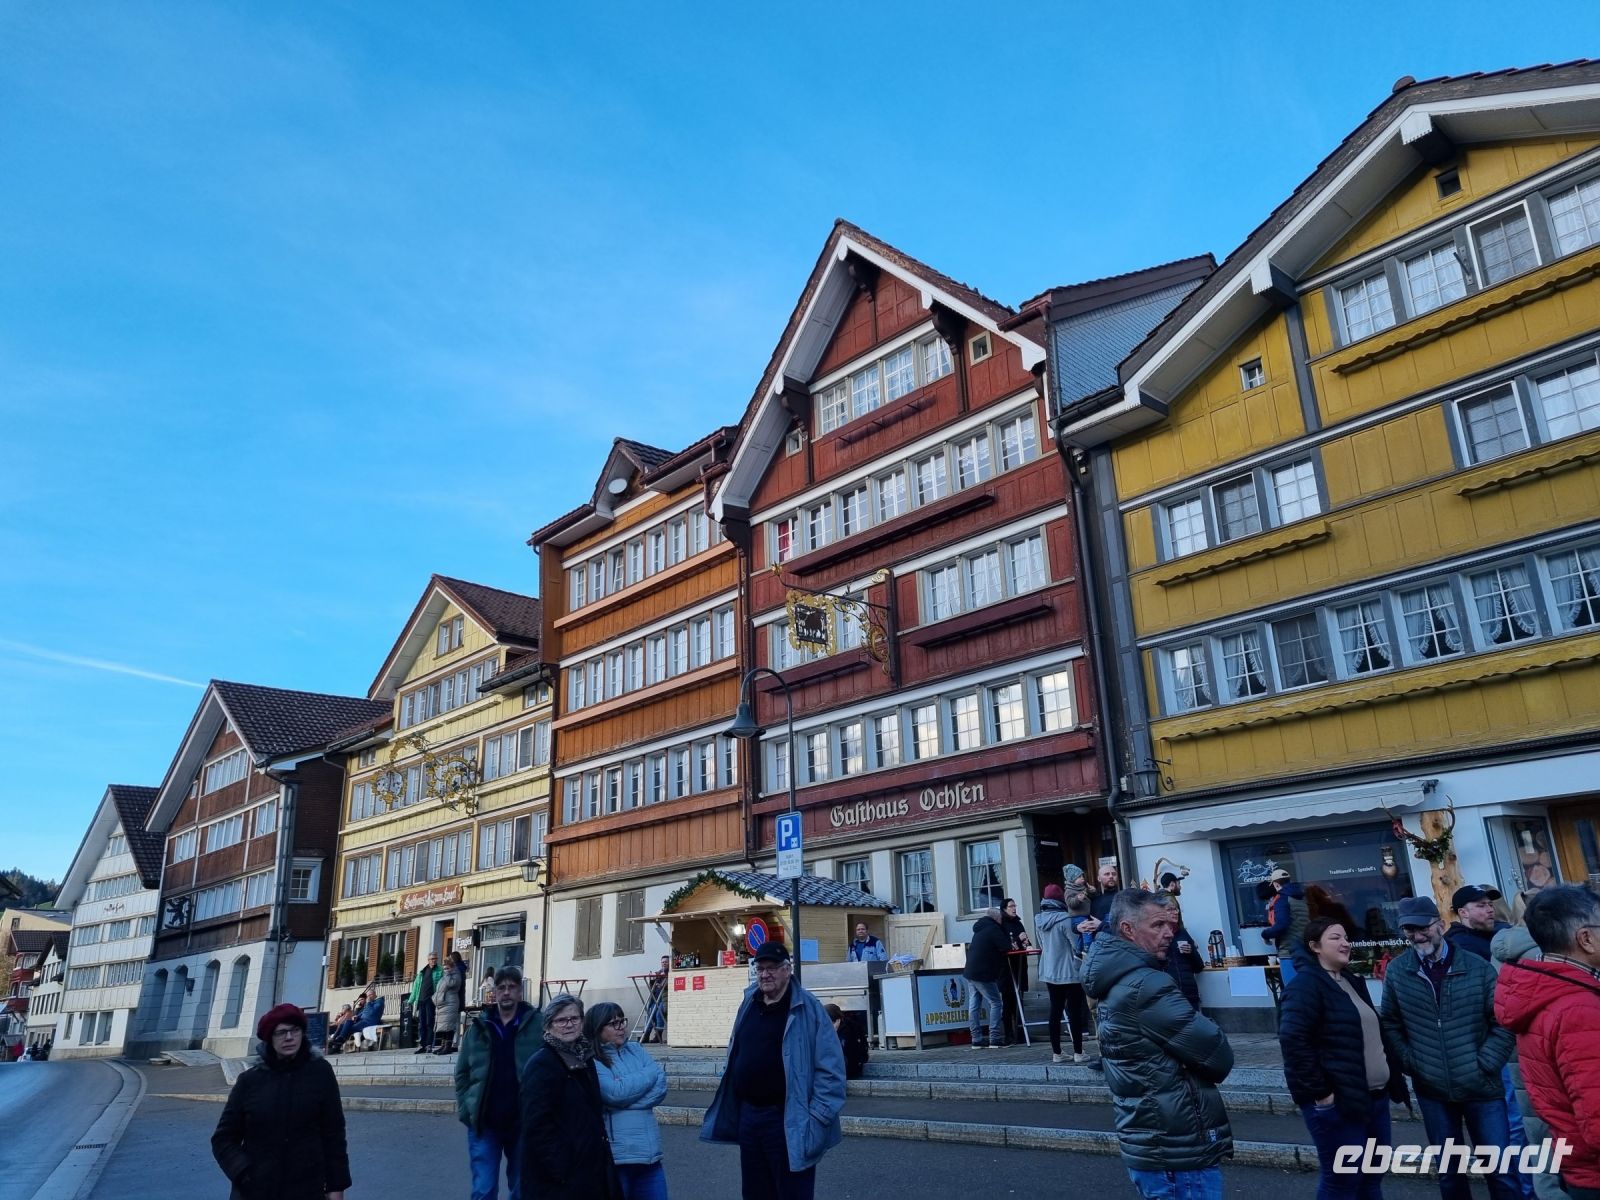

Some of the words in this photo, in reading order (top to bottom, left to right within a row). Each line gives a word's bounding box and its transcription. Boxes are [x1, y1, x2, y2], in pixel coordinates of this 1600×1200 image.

[830, 798, 909, 827] Gasthaus
[919, 781, 985, 811] Ochsen
[781, 819, 793, 847] P
